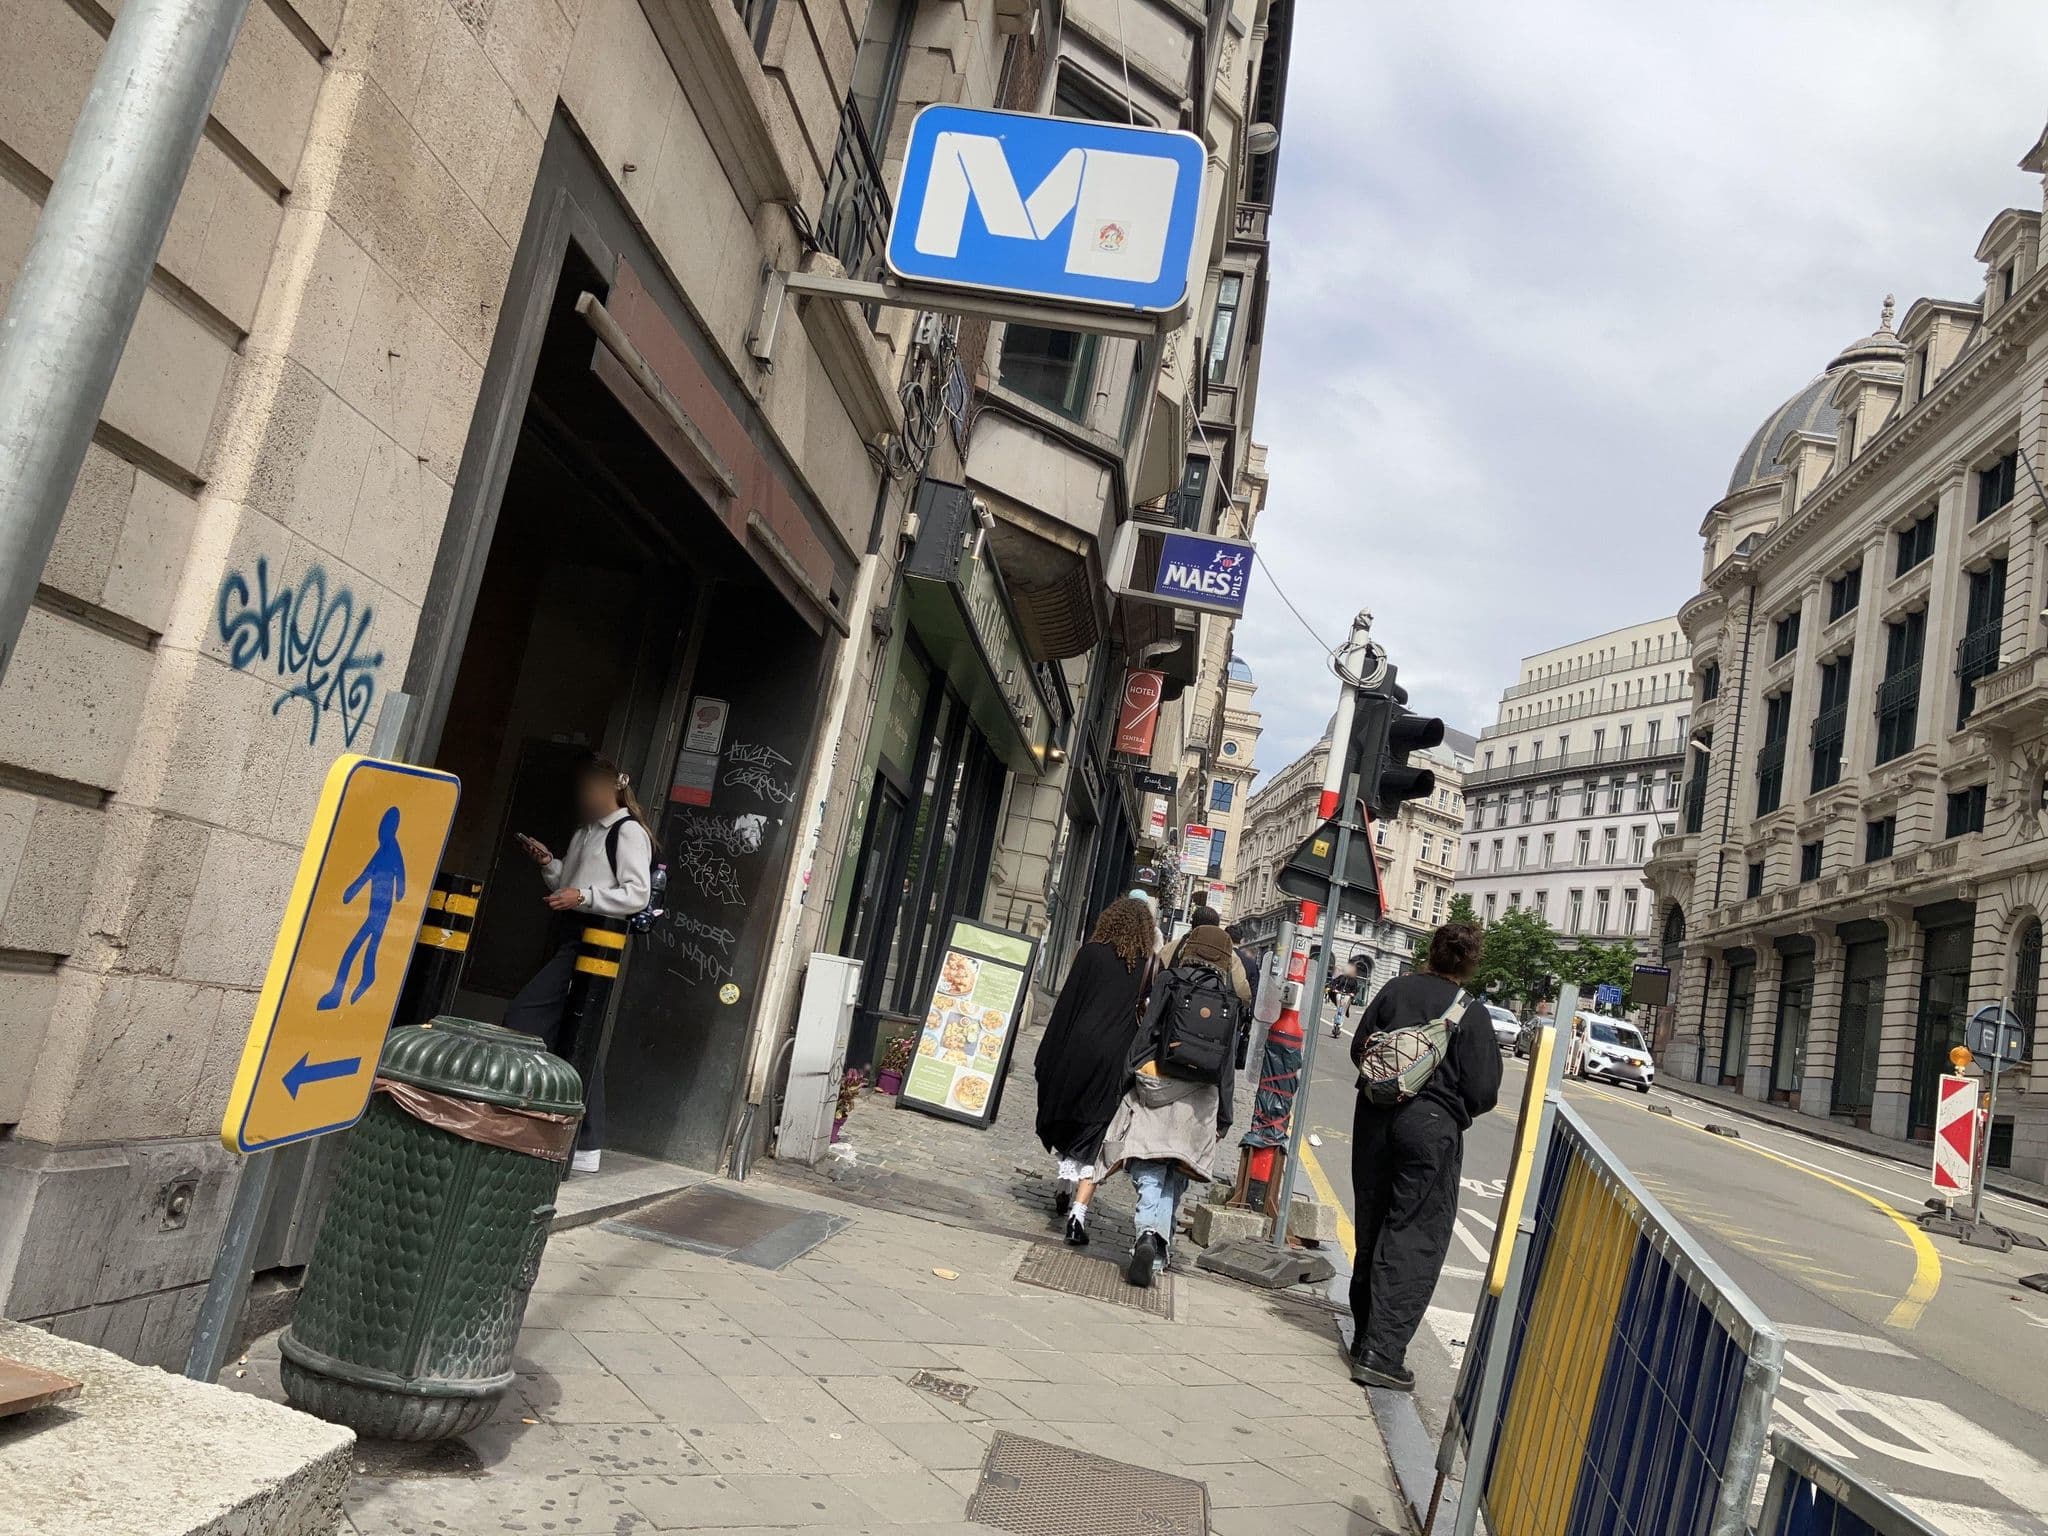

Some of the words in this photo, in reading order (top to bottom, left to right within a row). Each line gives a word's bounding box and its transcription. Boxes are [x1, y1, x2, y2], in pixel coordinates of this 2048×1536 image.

[914, 131, 1180, 284] M
[1163, 563, 1232, 596] MAES
[1231, 575, 1244, 597] PILS
[1130, 686, 1156, 697] HOTEL
[1122, 734, 1147, 744] CENTRAL
[674, 911, 736, 955] BORDER
